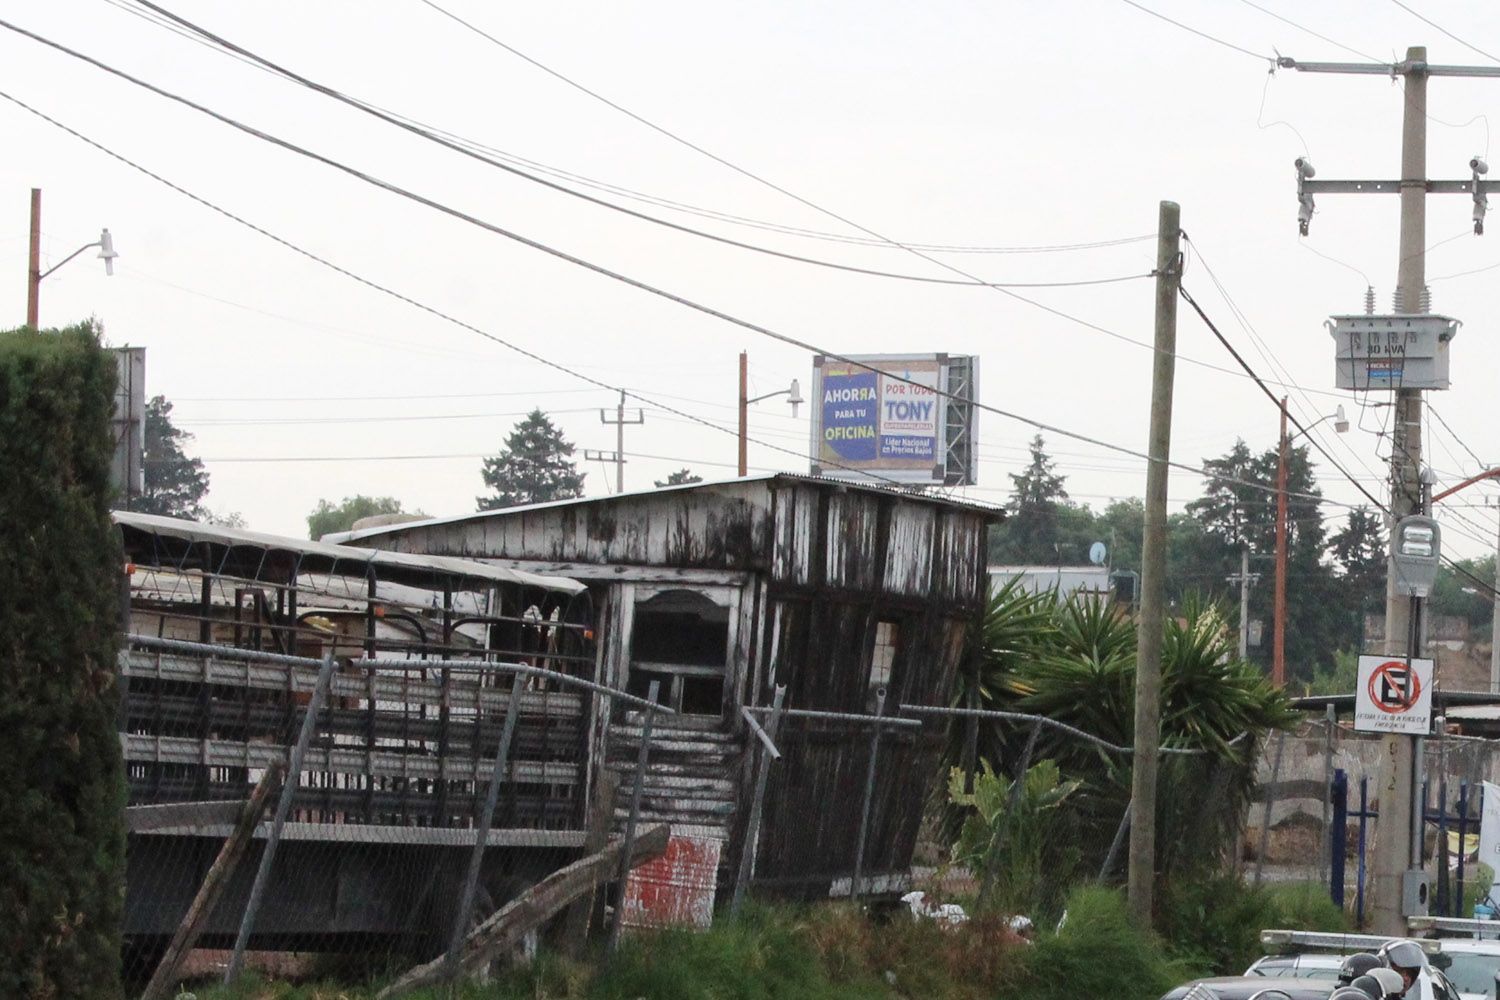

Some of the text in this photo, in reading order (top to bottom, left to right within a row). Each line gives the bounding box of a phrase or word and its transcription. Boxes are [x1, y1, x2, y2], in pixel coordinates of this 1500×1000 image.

[886, 384, 934, 395] POR TODO
[825, 388, 876, 403] AHORRA
[835, 409, 866, 419] PARA TU
[885, 401, 933, 420] TONY
[825, 426, 876, 440] OFICINA
[902, 439, 930, 447] Nacional
[891, 446, 914, 454] Precios
